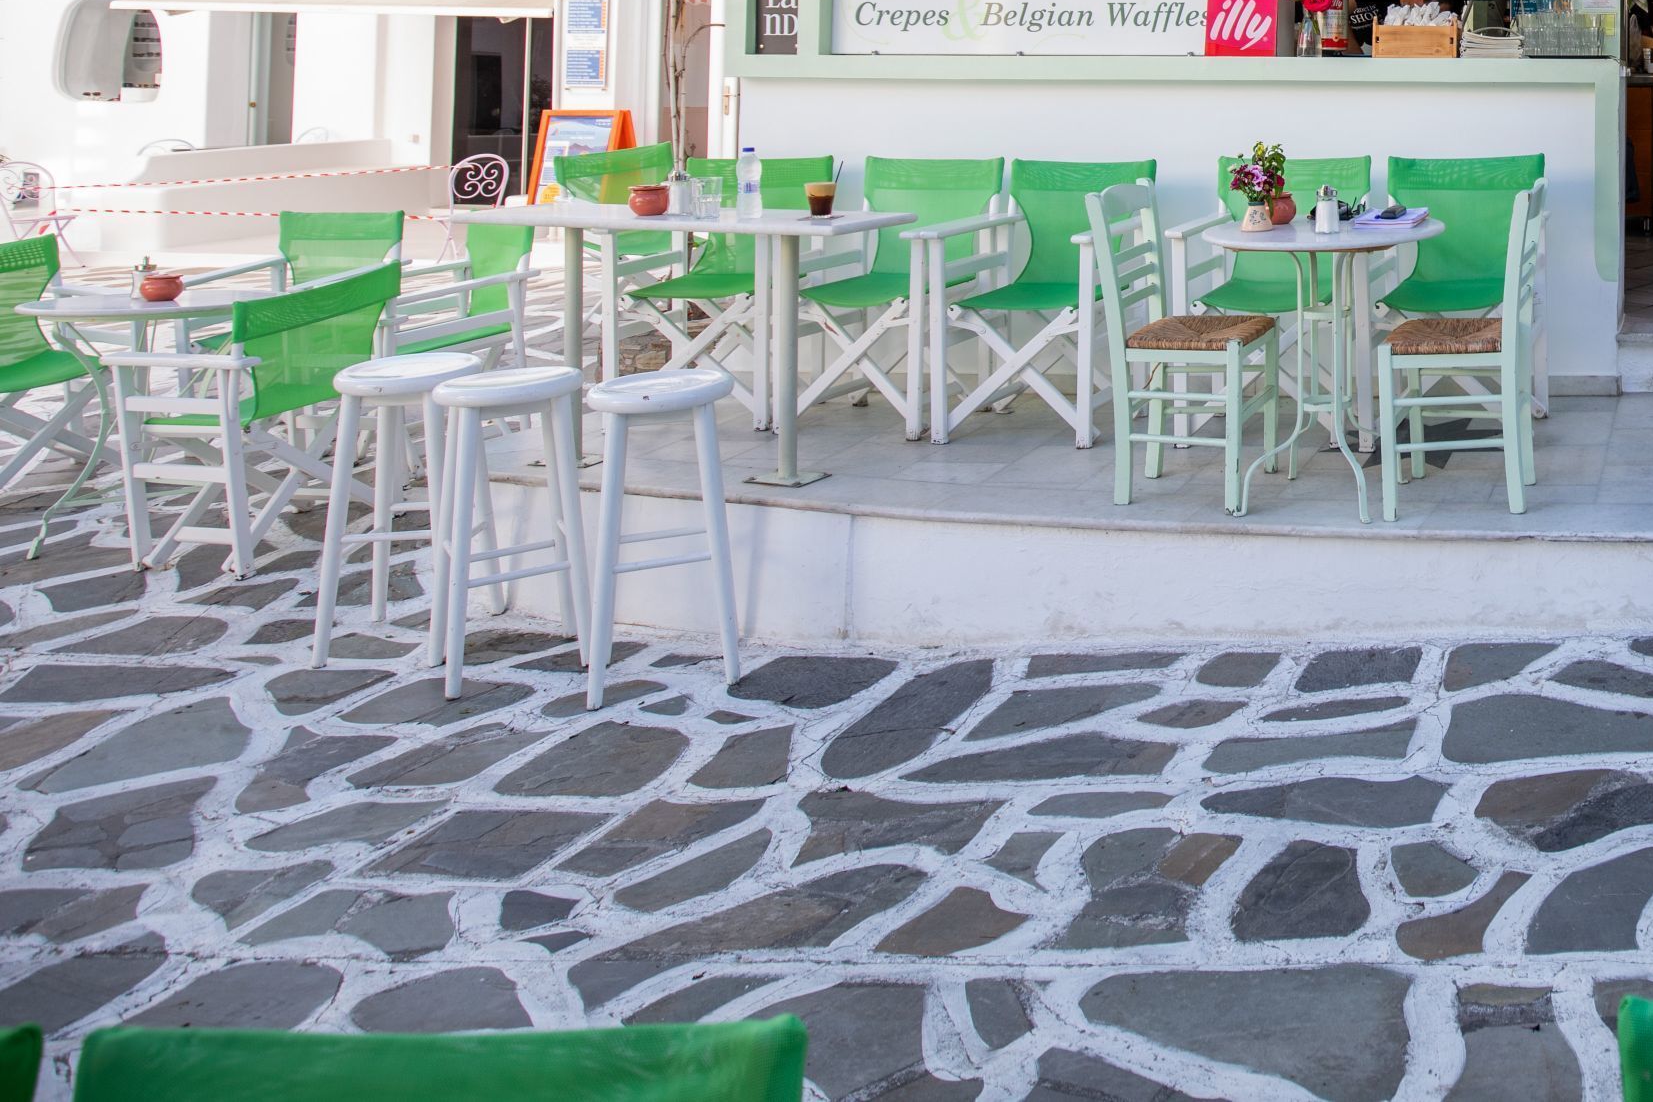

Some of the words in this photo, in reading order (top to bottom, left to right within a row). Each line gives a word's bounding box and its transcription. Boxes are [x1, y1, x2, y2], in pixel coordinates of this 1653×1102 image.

[854, 1, 950, 31] Crepes
[980, 1, 1094, 32] Belgian
[1107, 1, 1208, 32] Waffles
